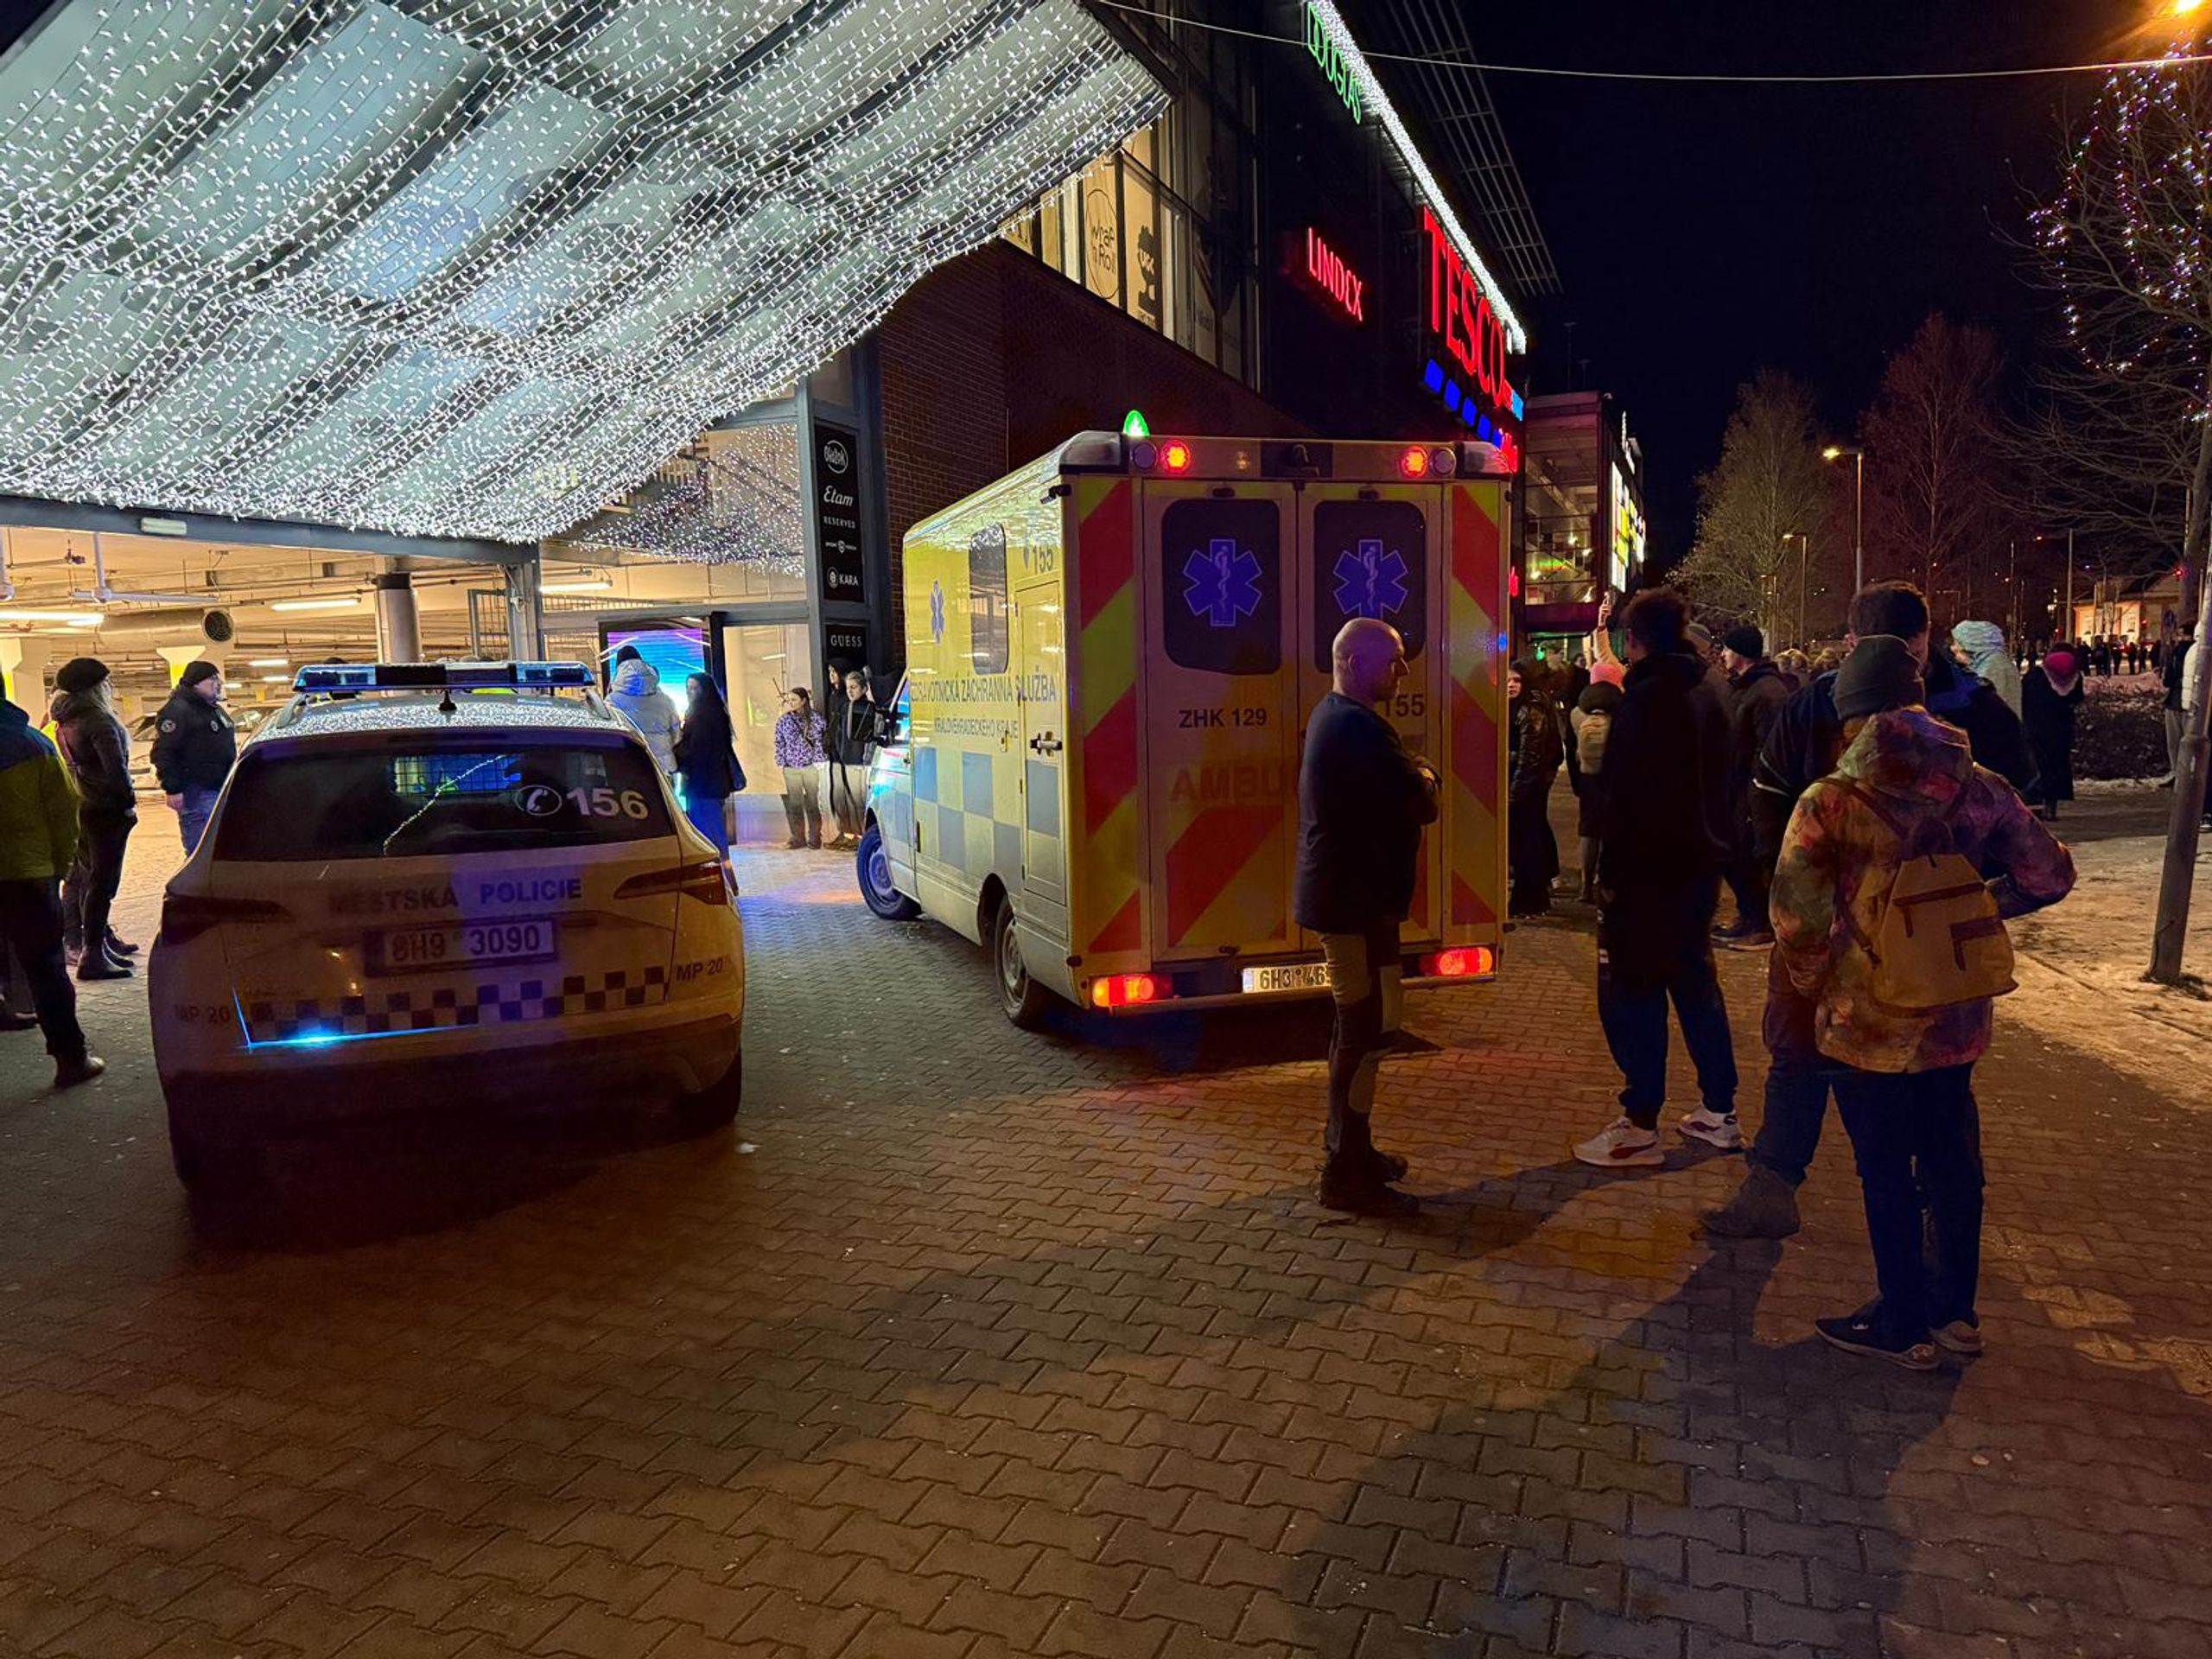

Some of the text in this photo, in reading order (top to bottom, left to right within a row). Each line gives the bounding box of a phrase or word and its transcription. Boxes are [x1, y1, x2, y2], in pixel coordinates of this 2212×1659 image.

[1307, 2, 1361, 124] DOUGLAS
[1308, 226, 1363, 321] LINDEX
[1423, 205, 1504, 408] TESCO
[823, 485, 854, 506] Etam
[1032, 544, 1054, 575] 155
[839, 573, 859, 587] KARA
[830, 635, 862, 648] GUESS
[1179, 708, 1268, 729] ZHK 129
[1381, 694, 1426, 718] 155
[566, 787, 648, 820] 156
[480, 878, 582, 905] POLICIE
[469, 925, 540, 956] 3090
[677, 962, 703, 982] MP
[1260, 969, 1291, 989] 6H3
